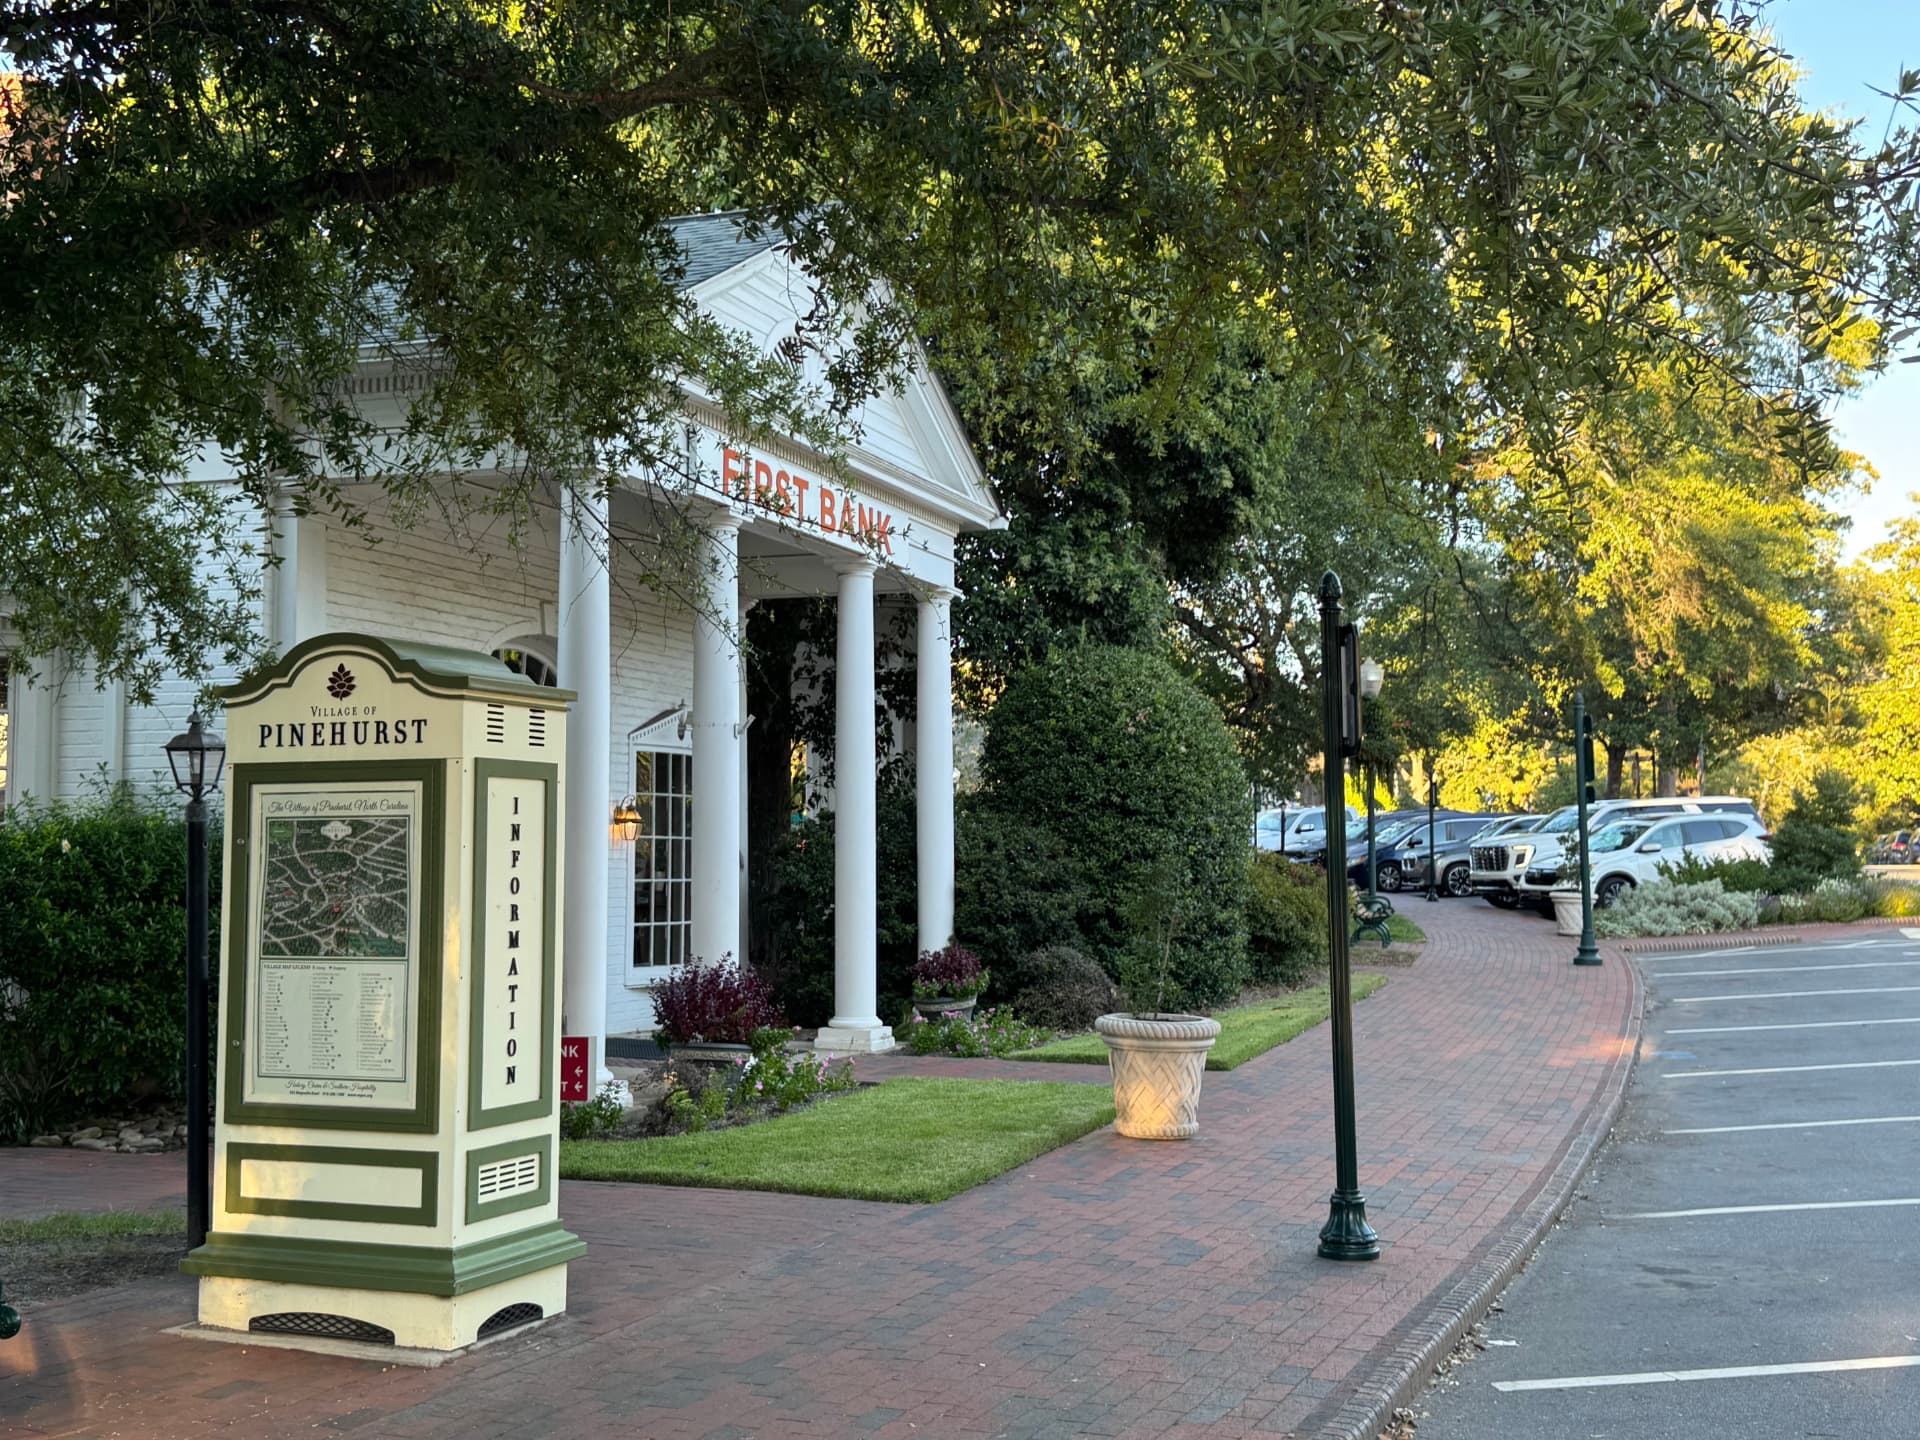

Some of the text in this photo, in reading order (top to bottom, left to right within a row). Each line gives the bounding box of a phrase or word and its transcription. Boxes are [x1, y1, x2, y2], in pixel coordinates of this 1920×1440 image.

[723, 447, 892, 556] FIRST BANK
[311, 706, 377, 717] VILLAGE OF
[259, 719, 427, 748] PINEHURST
[268, 801, 284, 813] The
[284, 799, 311, 814] Village
[311, 801, 319, 814] of
[353, 798, 378, 812] North
[379, 798, 409, 811] Carolina
[505, 797, 521, 1085] INFORMATION
